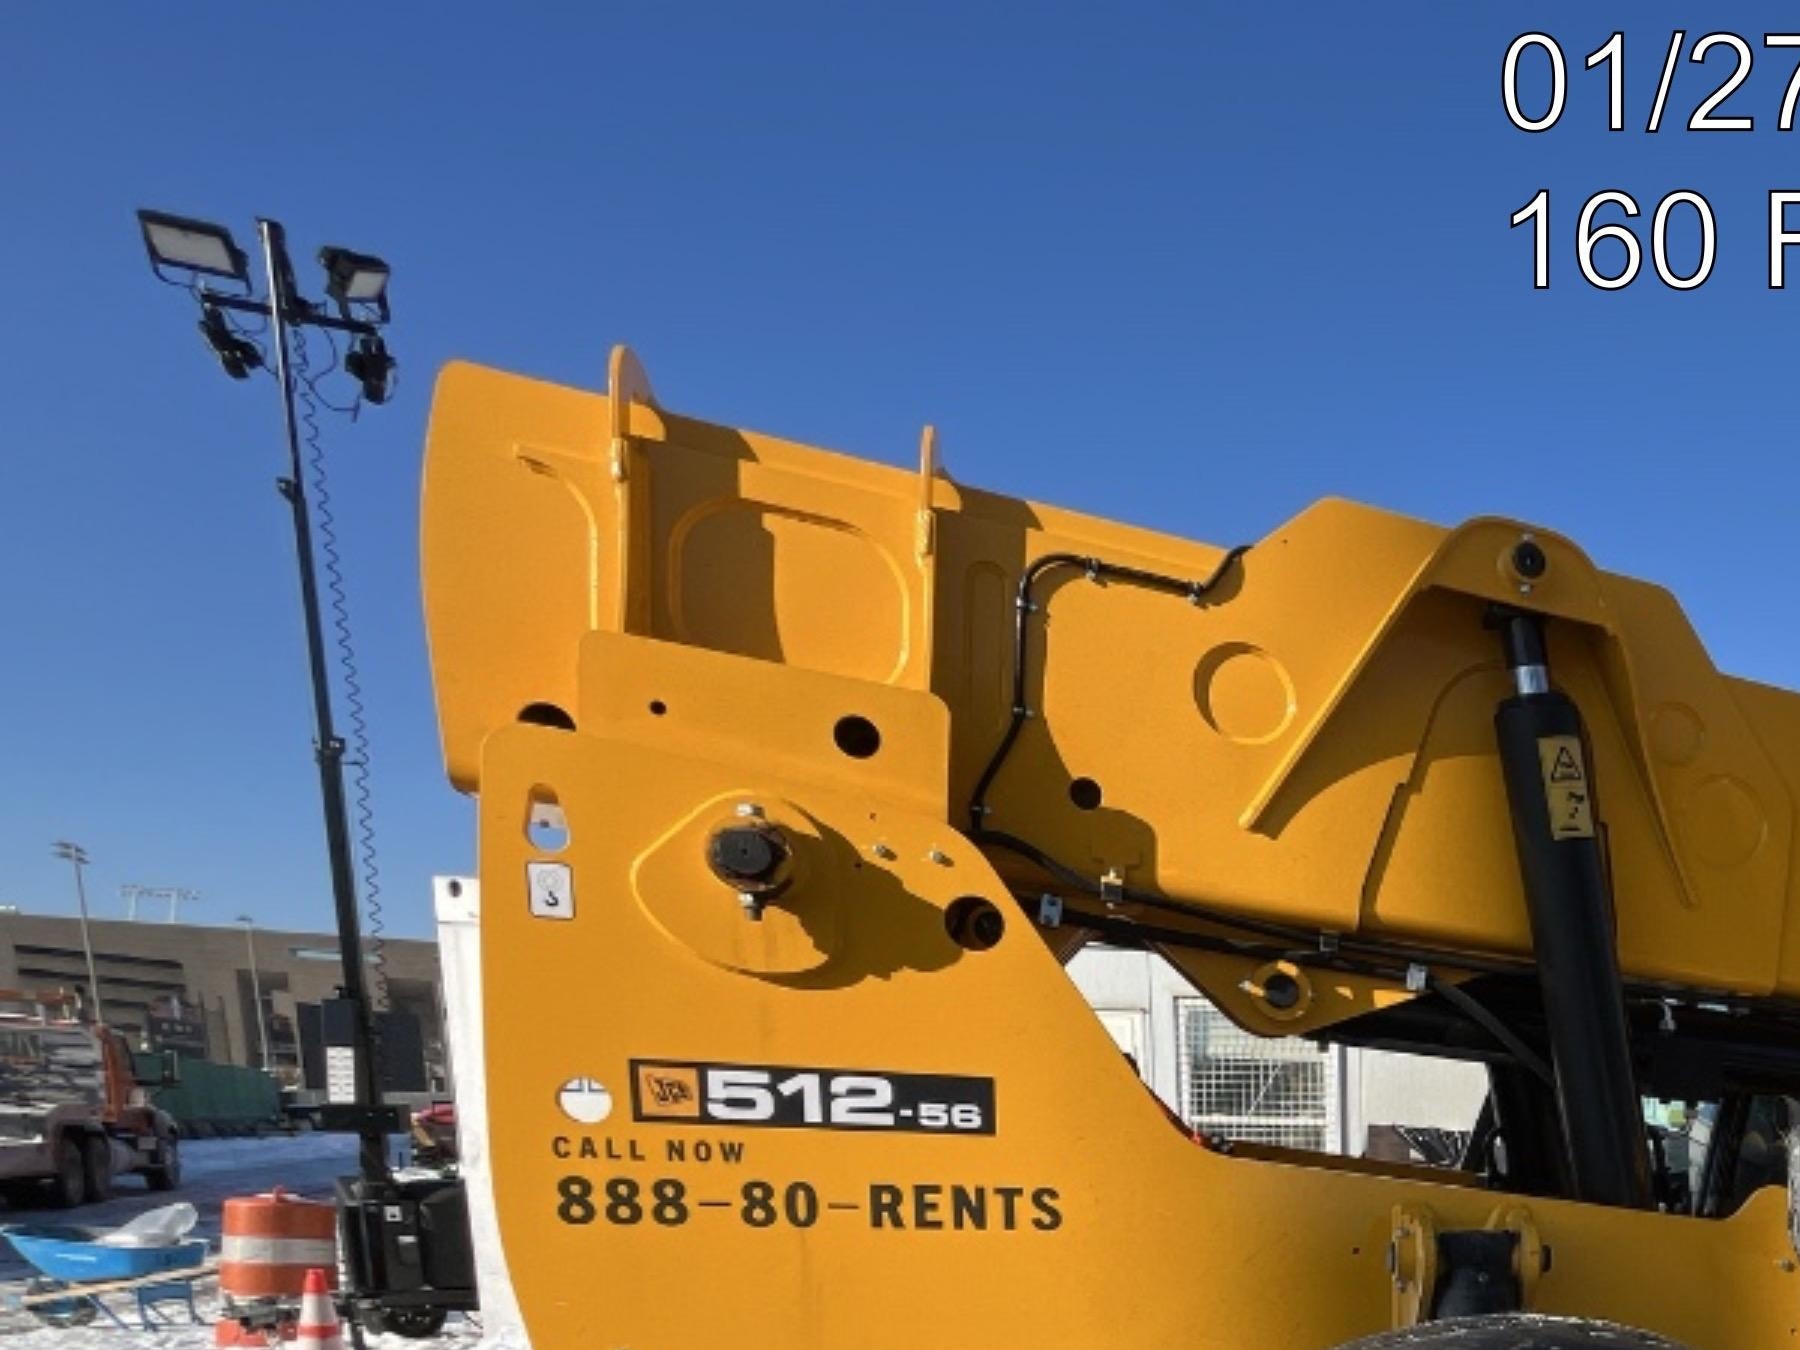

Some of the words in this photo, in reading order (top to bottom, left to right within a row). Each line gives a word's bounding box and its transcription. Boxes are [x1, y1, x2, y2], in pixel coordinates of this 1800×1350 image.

[706, 1069, 982, 1130] 512-56
[552, 1136, 645, 1161] CALL
[667, 1138, 746, 1164] NOW
